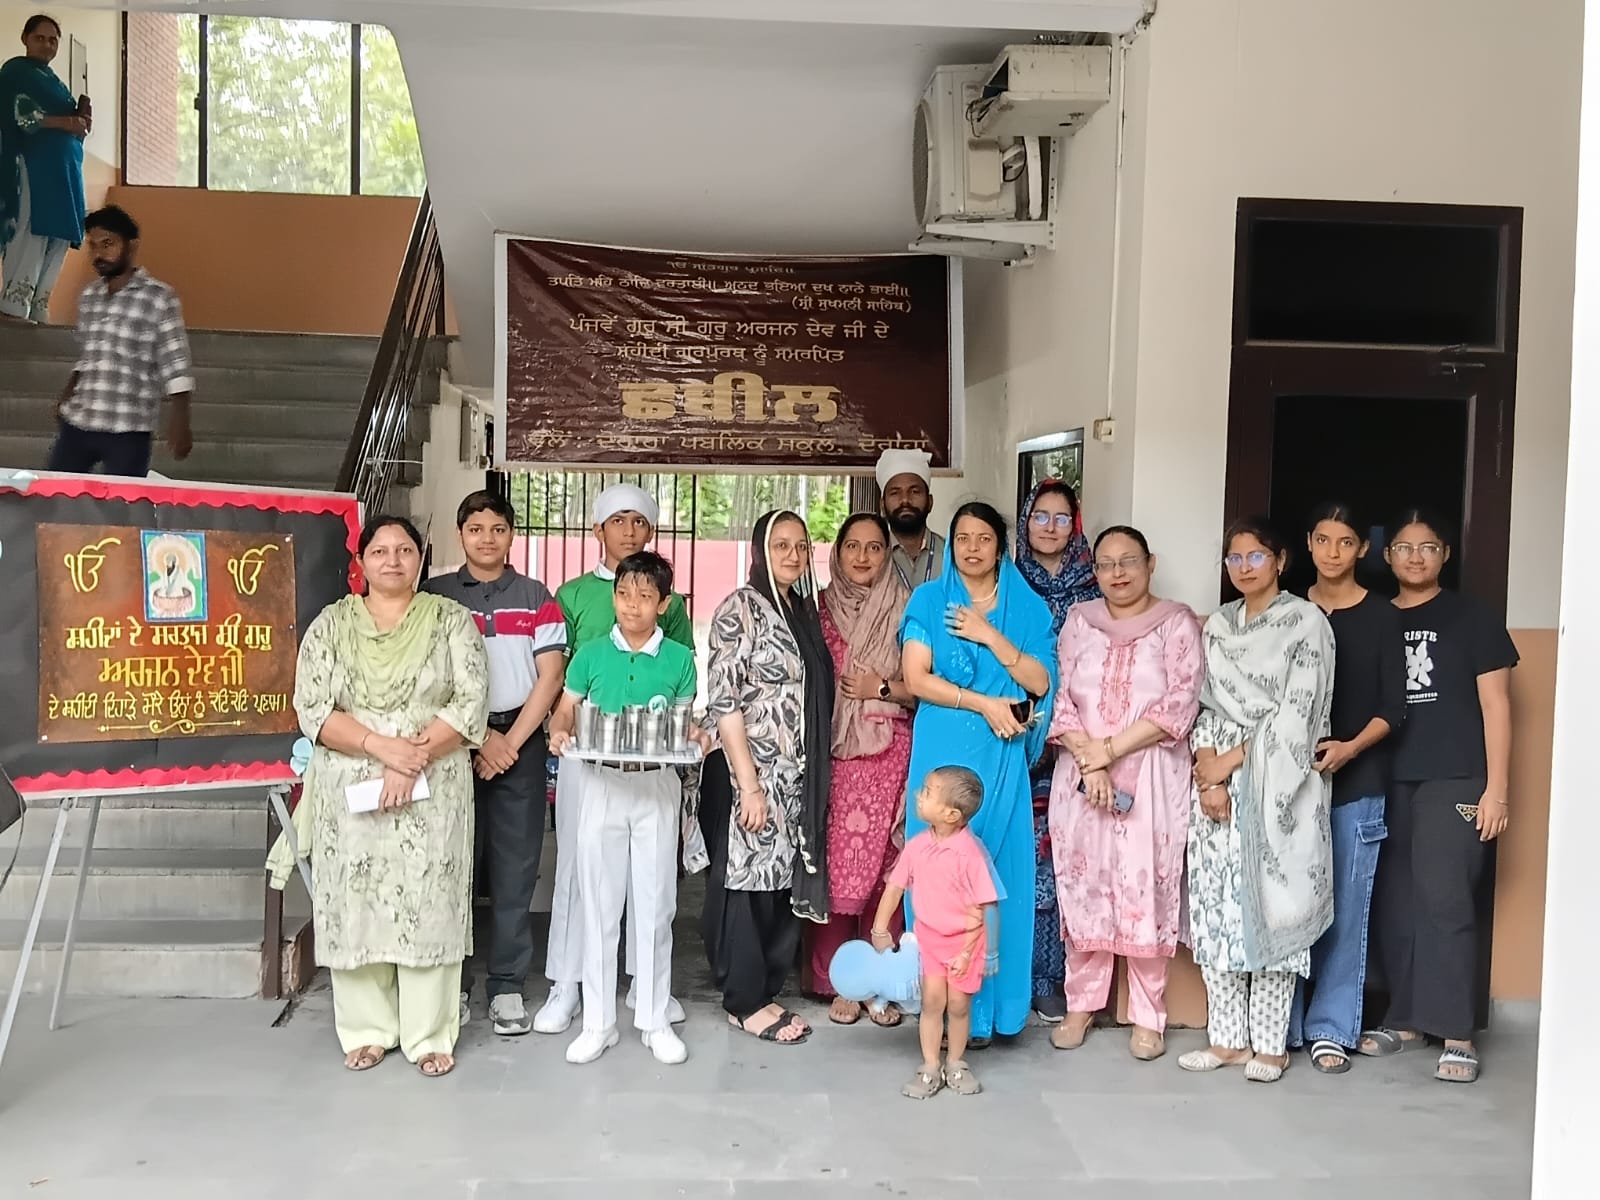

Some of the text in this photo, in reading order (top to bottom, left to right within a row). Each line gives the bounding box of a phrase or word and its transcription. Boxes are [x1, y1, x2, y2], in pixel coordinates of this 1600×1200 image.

[811, 282, 834, 296] ਦੁਖ
[818, 298, 863, 312] ਸੁਖਮਨੀ
[626, 319, 657, 339] ਗੁਰੂ
[697, 320, 729, 340] ਗੁਰੂ
[736, 321, 799, 336] ਅਰਜਨ
[806, 318, 836, 338] ਦੇਵ
[843, 320, 867, 339] ਜੀ
[873, 320, 890, 339] ਦੇ
[752, 344, 768, 366] ਨੂੰ
[774, 345, 845, 363] ਸਮਰਪਿਤ
[618, 371, 842, 423] ਛਬੀਲ
[64, 537, 280, 596] ੴ ੴ
[64, 616, 125, 649] ਸ਼ਹੀਦਾਂ
[127, 615, 144, 647] ਦੇ
[244, 624, 273, 651] ਗੁਰੂ
[98, 645, 246, 688] ਅਰਜਨ ਦੇਵ ਜੀ
[48, 693, 60, 719] ਦੇ
[62, 692, 98, 719] ਸ਼ਹੀਦੀ
